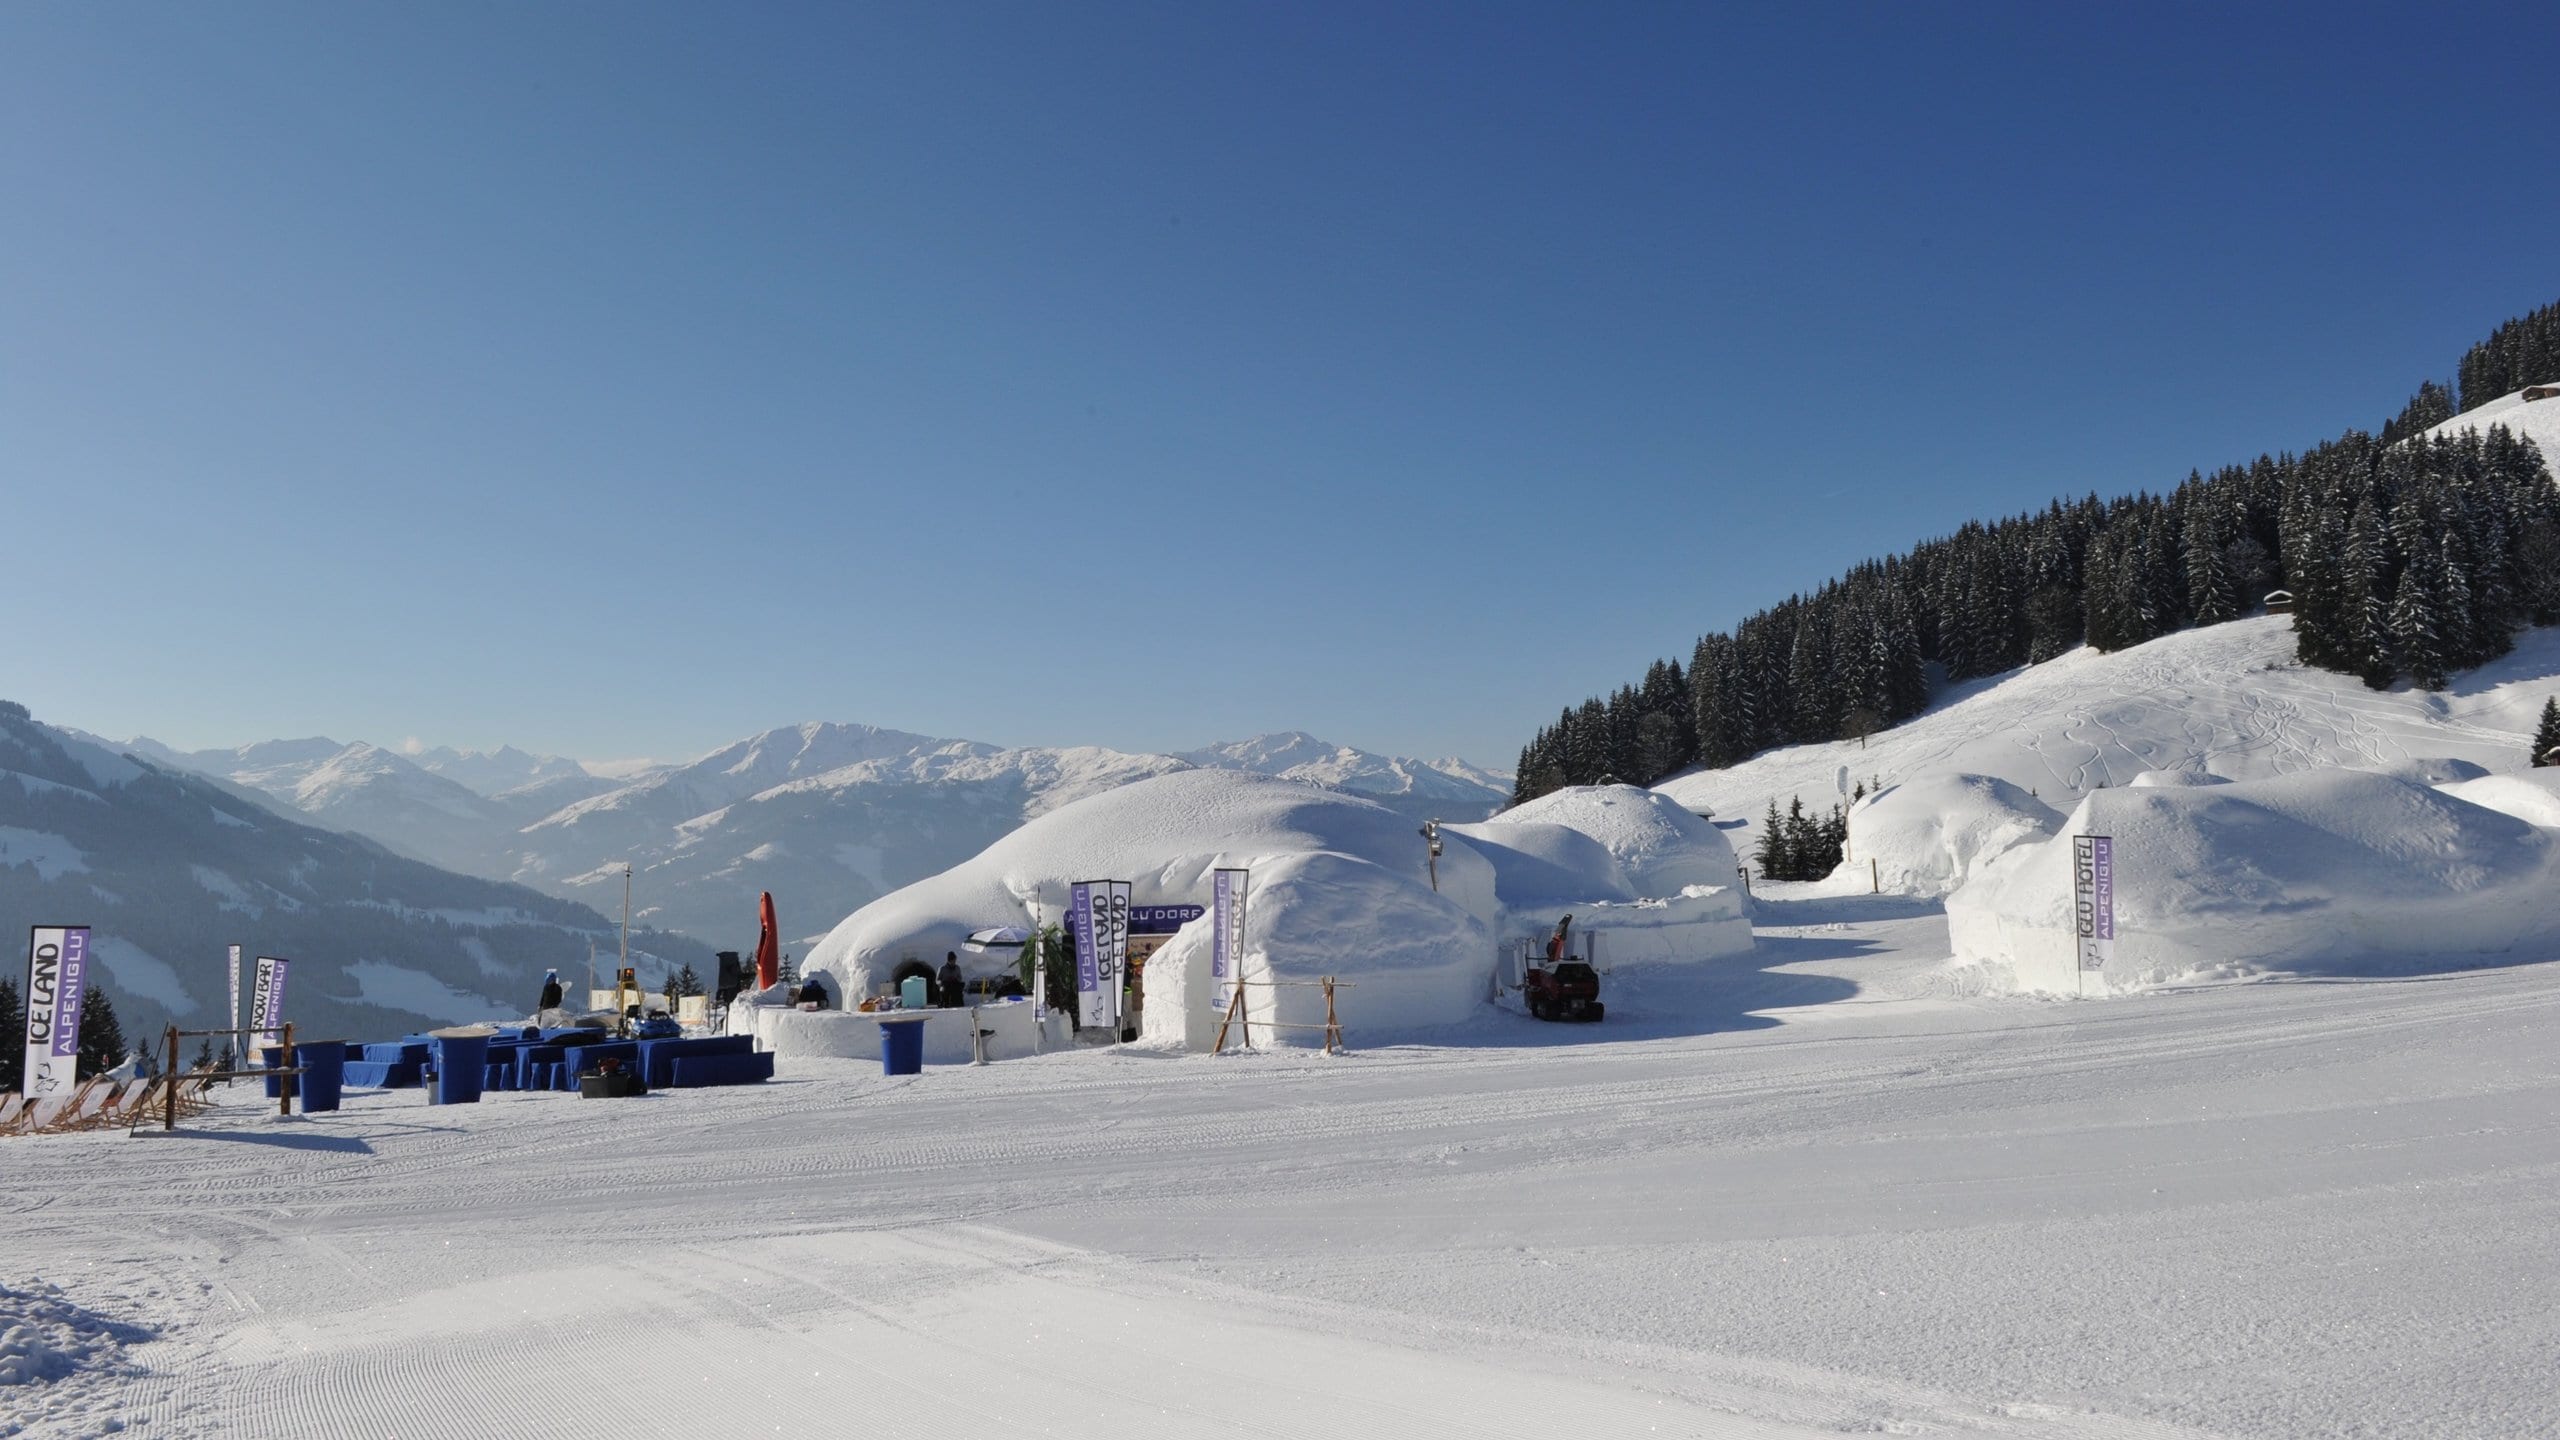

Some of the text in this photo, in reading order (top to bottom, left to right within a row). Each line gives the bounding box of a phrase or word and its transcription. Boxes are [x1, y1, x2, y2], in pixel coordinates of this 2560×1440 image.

[1154, 909, 1201, 920] DORF
[2077, 839, 2094, 939] IGLU HOTEL
[2099, 843, 2110, 938] ALPENIGLU
[30, 943, 59, 1045] ICE LAND
[59, 935, 83, 1053] ALPENIGLU
[257, 963, 273, 992] BAR
